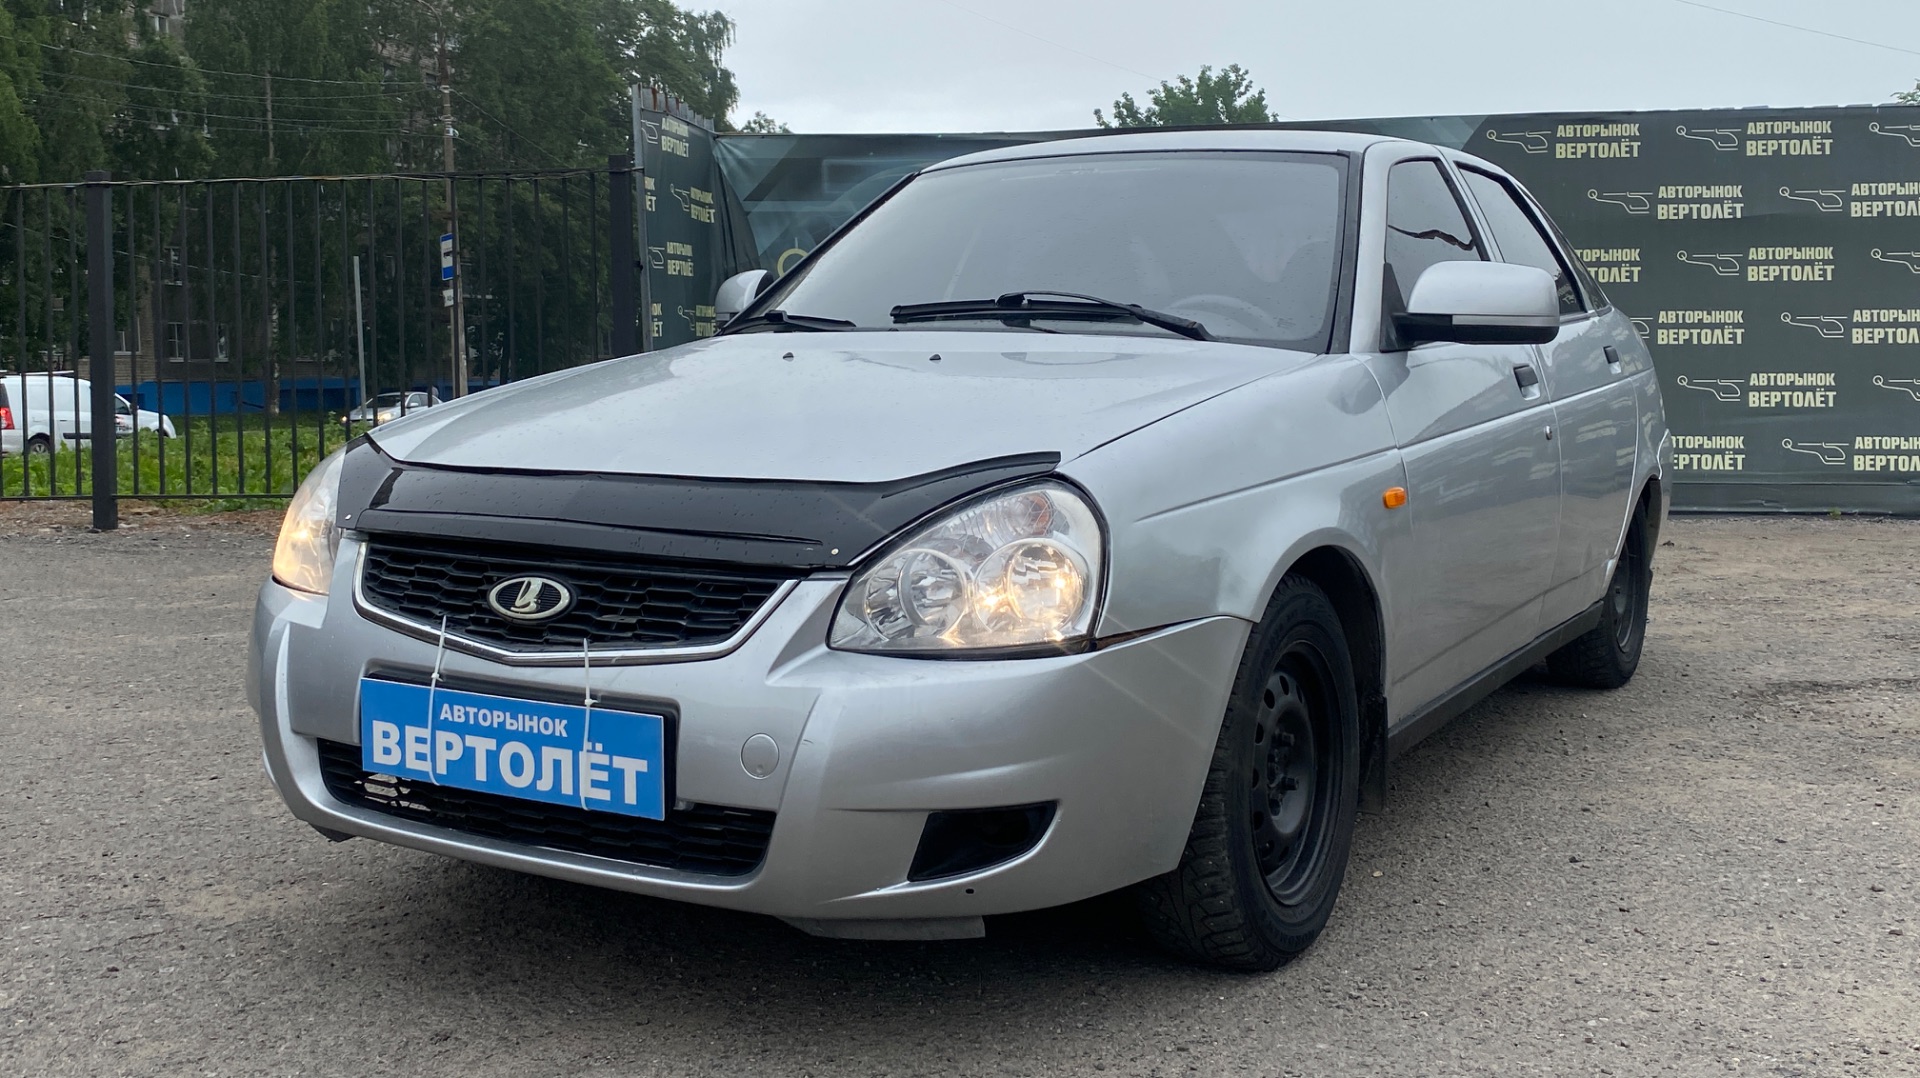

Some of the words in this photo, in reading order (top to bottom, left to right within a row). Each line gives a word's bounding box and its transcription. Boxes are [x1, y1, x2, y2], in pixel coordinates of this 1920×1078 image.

[1556, 123, 1640, 138] АВТОРЫНОК
[1747, 120, 1832, 135] АВТОРЫНОК
[1555, 138, 1641, 159] ВЕРТОЛЁТ
[1746, 135, 1833, 156] ВЕРТОЛЁТ
[1658, 185, 1743, 199] АВТОРЫНОК
[1851, 182, 1920, 196] АВТОРЫН
[1657, 200, 1744, 220] ВЕРТОЛЁТ
[1850, 197, 1920, 217] ВЕРТОЛ
[1574, 248, 1641, 262] ТОРЫНОК
[1748, 246, 1834, 260] АВТОРЫНОК
[1587, 263, 1642, 283] ТОЛЁТ
[1747, 261, 1835, 281] ВЕРТОЛЁТ
[1658, 310, 1744, 324] АВТОРЫНОК
[1852, 309, 1920, 323] АВТОРЫН
[1657, 325, 1745, 345] ВЕРТОЛЁТ
[1852, 327, 1920, 345] ВЕРТОЛ
[1749, 372, 1836, 386] АВТОРЫНОК
[1748, 387, 1837, 408] ВЕРТОЛЁТ
[1671, 435, 1745, 449] ТОРЫНОК
[1854, 436, 1920, 450] АВТОРЫН
[1853, 454, 1920, 472] ВЕРТОЛ
[440, 703, 568, 738] АВТОРЫНОК
[372, 720, 648, 806] ВЕРТОЛЁТ
